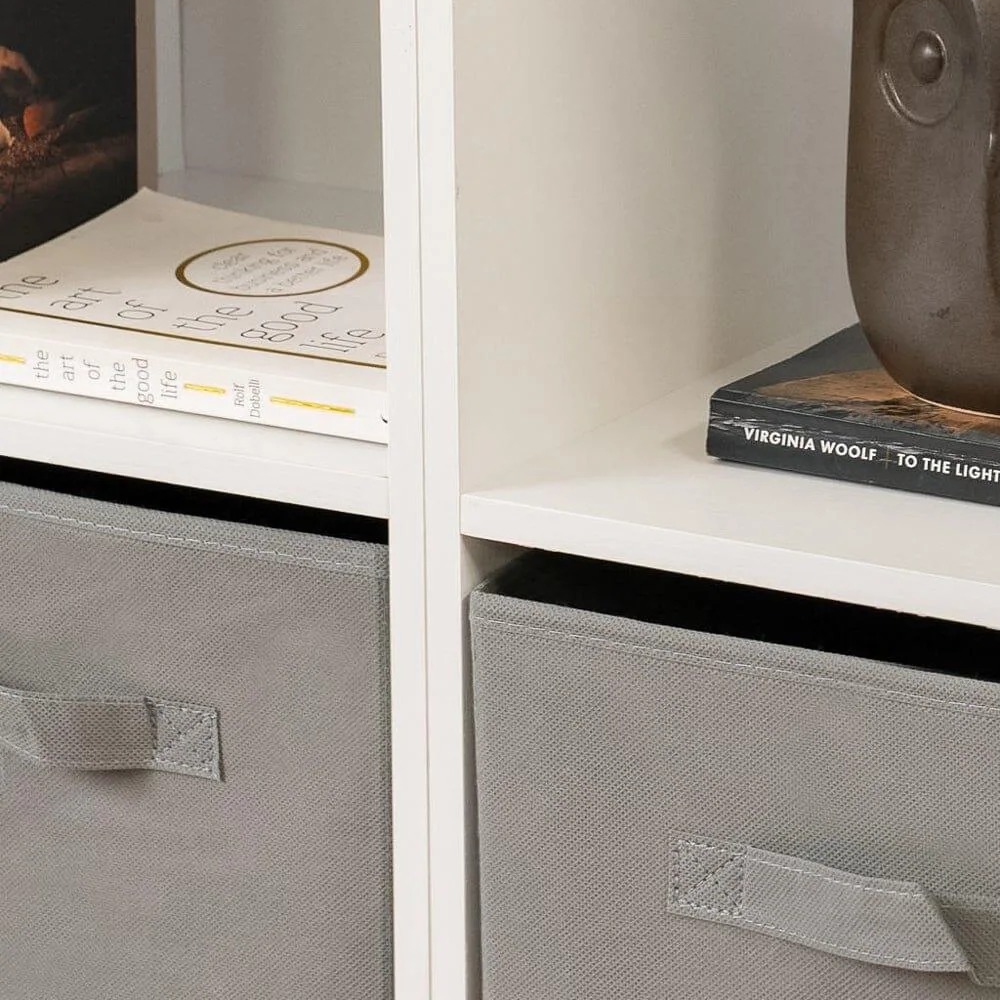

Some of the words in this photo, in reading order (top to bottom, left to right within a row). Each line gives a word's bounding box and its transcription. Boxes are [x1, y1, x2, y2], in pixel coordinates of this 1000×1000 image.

[50, 287, 122, 311] art
[117, 299, 168, 320] of
[172, 306, 253, 331] the
[240, 301, 343, 343] good
[299, 328, 385, 353] life
[33, 350, 49, 379] the
[60, 354, 74, 381] art
[83, 359, 100, 380] of
[109, 362, 126, 391] the
[131, 357, 155, 404] good
[160, 370, 178, 399] life
[250, 378, 260, 418] Dobelli
[744, 427, 816, 451] VIRGINIA
[820, 440, 877, 462] WOOLF
[897, 453, 918, 468] TO
[923, 457, 951, 475] THE
